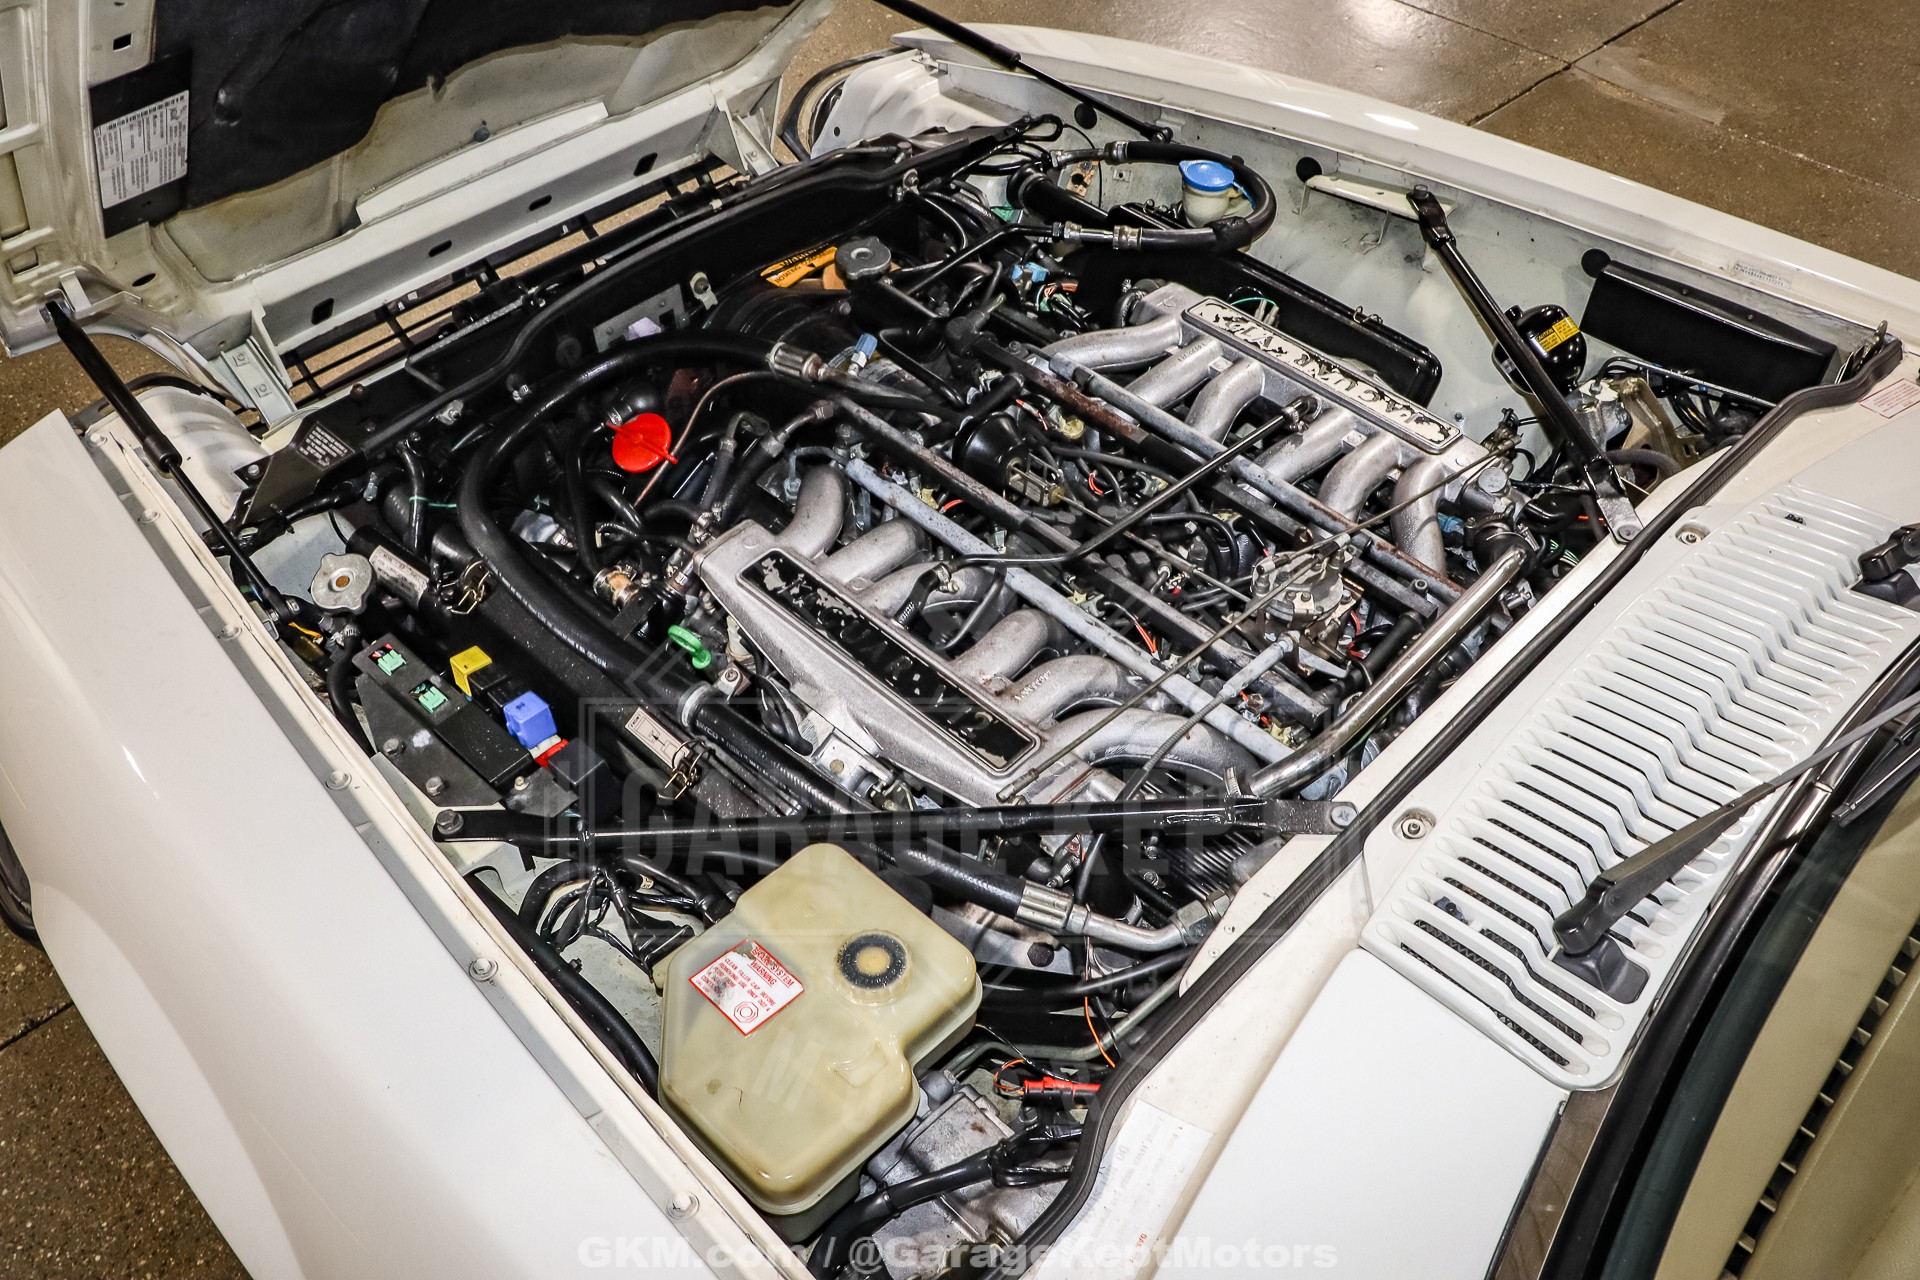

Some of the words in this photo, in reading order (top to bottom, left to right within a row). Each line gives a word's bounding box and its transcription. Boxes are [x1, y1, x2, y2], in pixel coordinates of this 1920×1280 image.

[724, 958, 738, 971] CLEAN
[750, 959, 777, 986] WARNING
[770, 961, 795, 987] SYSTEM
